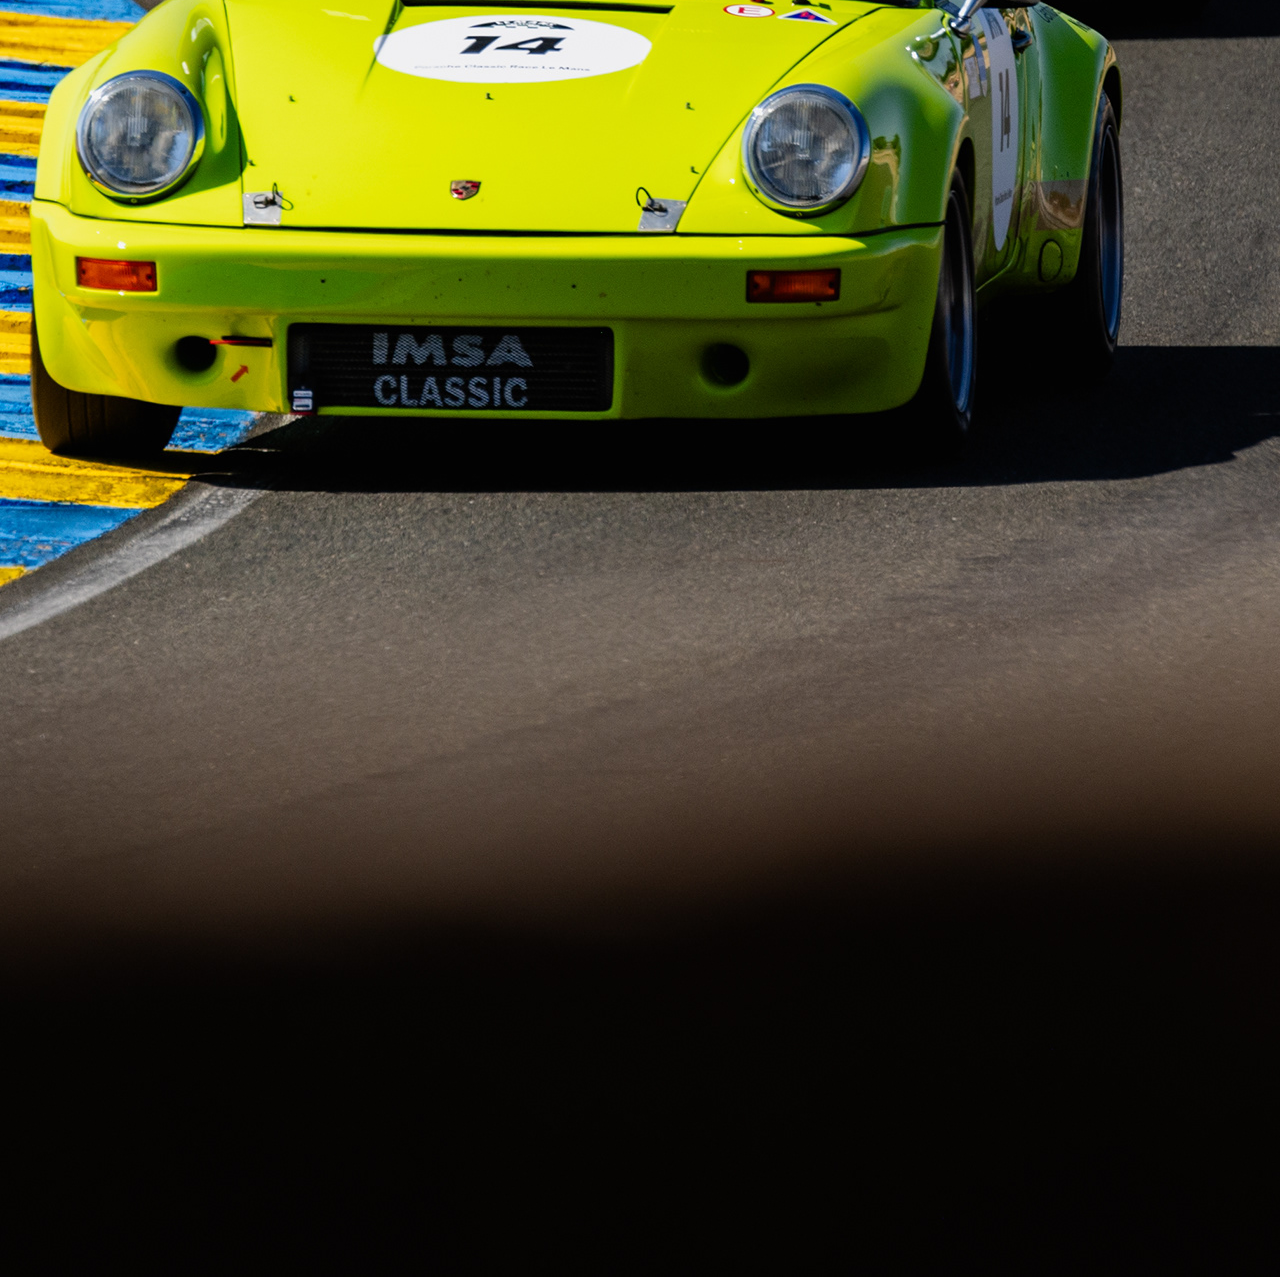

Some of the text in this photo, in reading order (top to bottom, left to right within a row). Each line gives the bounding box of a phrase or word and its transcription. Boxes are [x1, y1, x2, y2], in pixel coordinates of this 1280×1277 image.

[459, 36, 567, 55] 14
[372, 332, 534, 368] IMSA
[373, 374, 528, 408] CLASSIC
